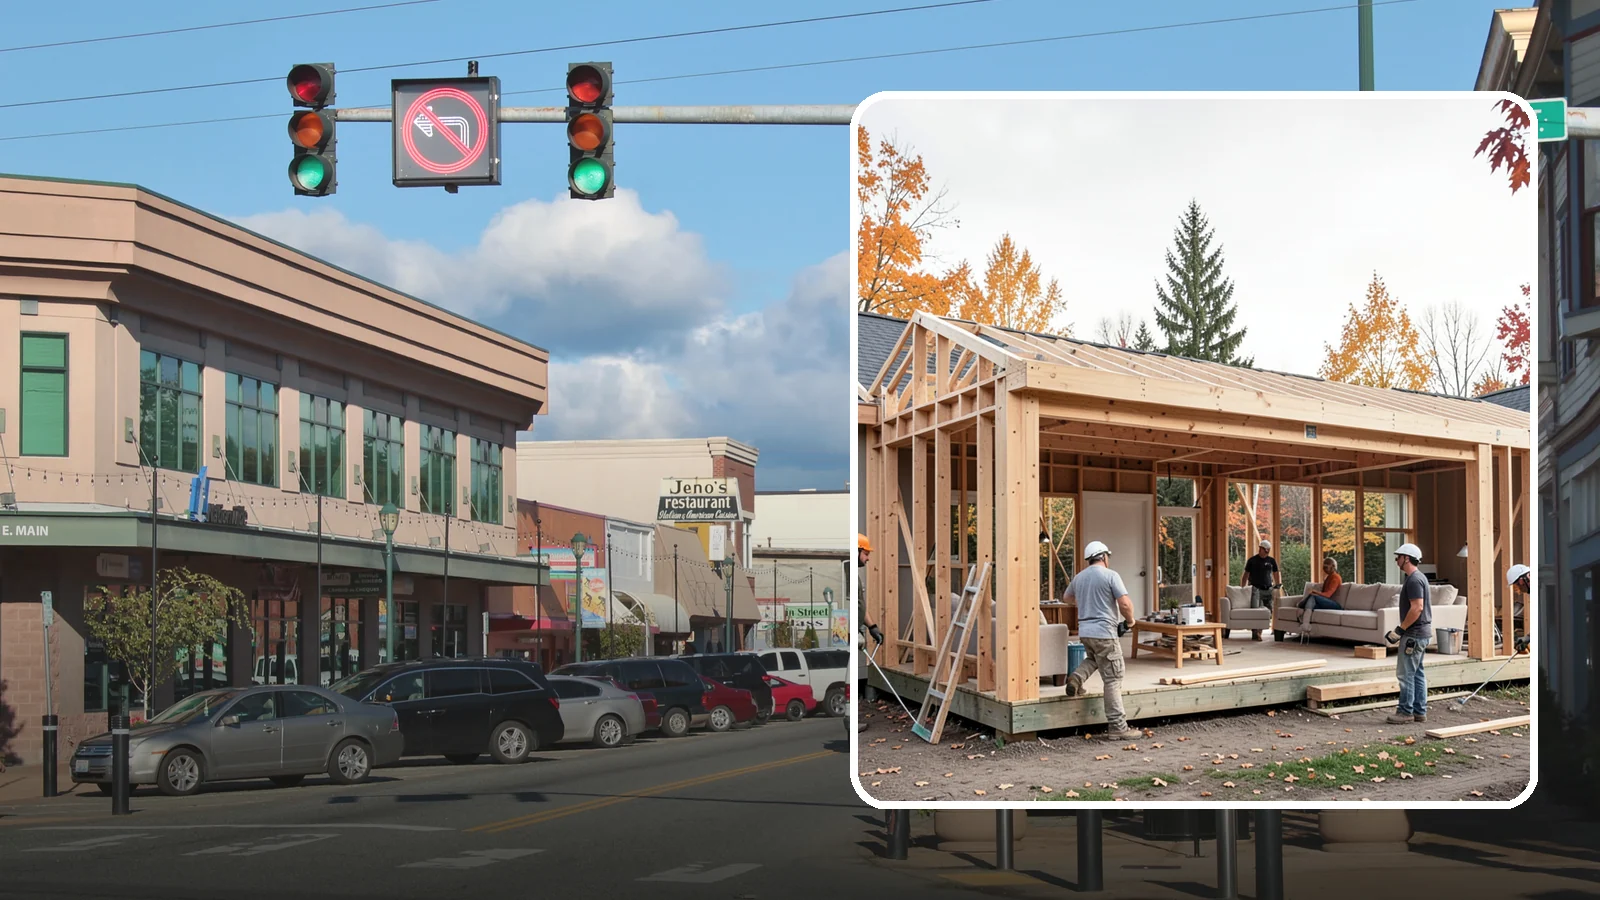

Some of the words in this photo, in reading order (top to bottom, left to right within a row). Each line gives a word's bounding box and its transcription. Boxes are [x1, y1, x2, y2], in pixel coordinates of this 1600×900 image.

[670, 480, 727, 494] Jeno's
[665, 496, 731, 509] restaurant
[659, 509, 681, 519] Italian
[686, 509, 714, 519] American
[715, 509, 737, 519] Cuisine
[2, 525, 13, 536] E.
[15, 525, 49, 536] MAIN
[797, 606, 828, 617] Street
[790, 619, 824, 627] lass
